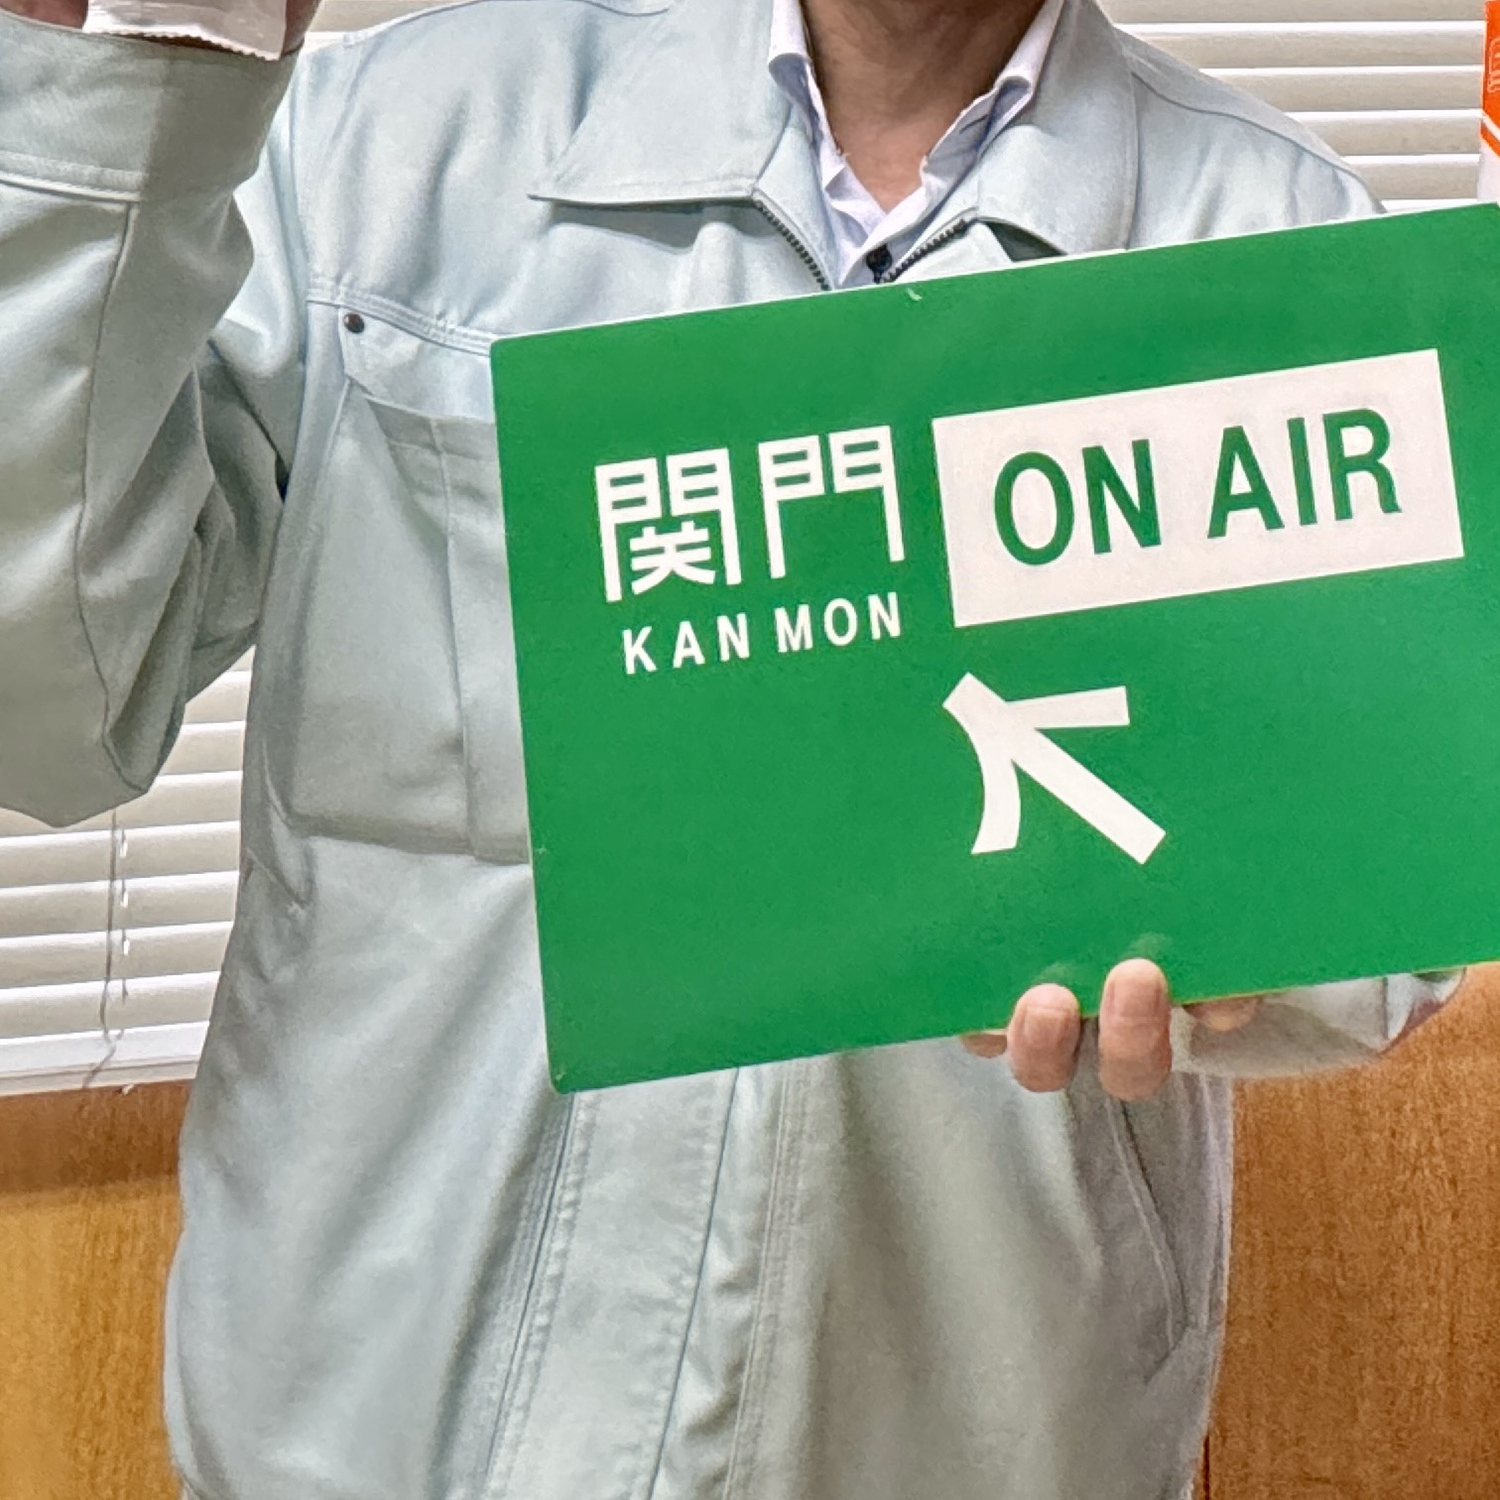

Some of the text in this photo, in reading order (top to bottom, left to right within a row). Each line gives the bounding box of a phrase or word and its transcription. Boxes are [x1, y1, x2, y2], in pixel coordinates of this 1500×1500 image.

[594, 407, 1403, 603] 関門 ON AIR
[621, 591, 902, 676] KAN MON
